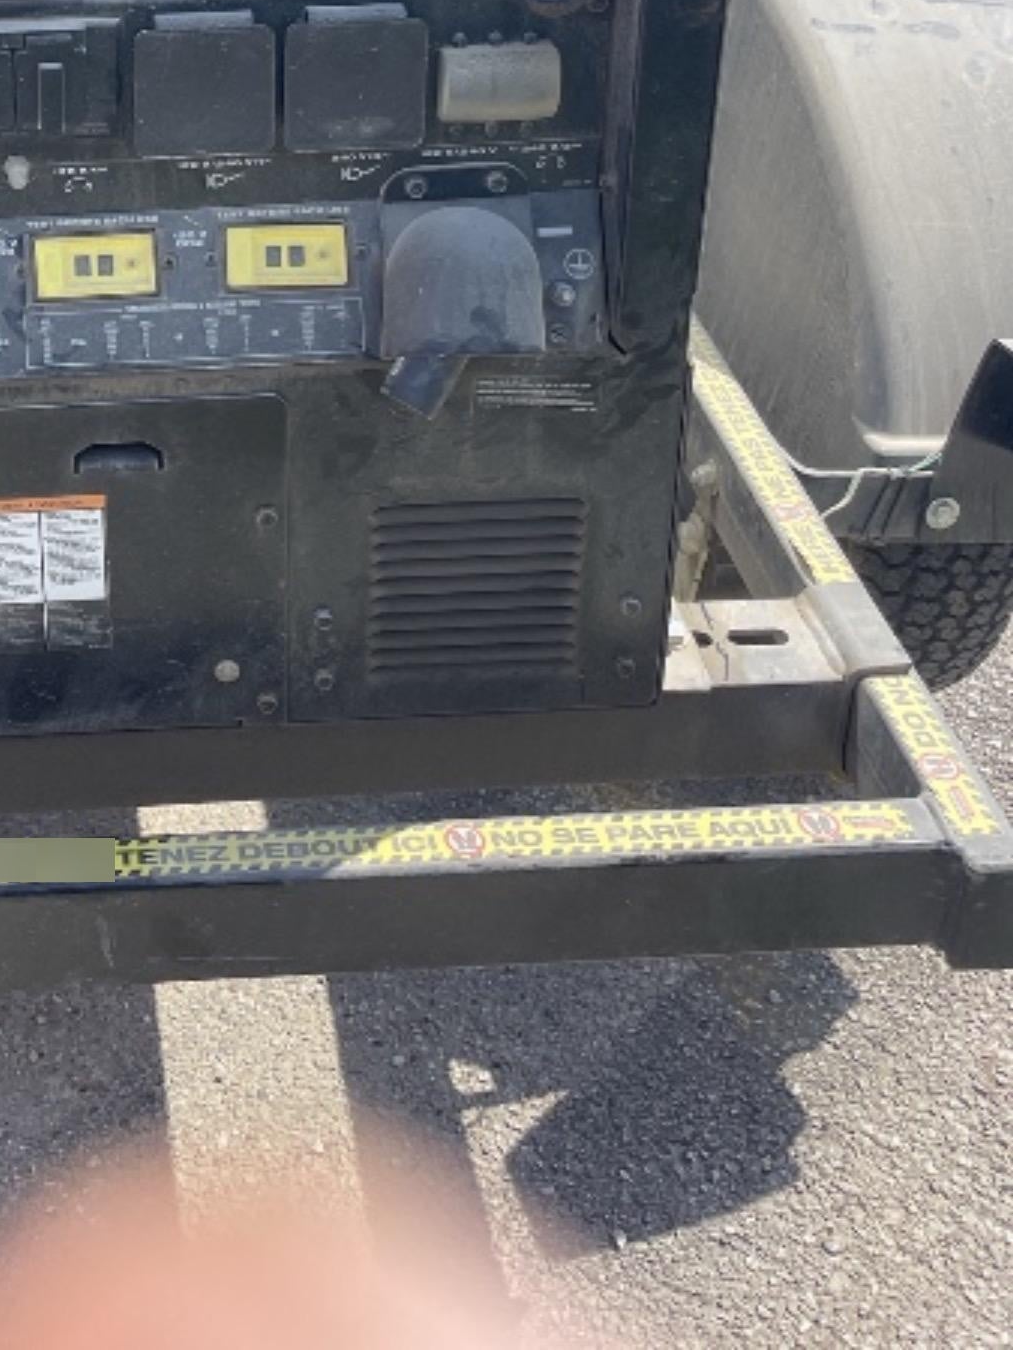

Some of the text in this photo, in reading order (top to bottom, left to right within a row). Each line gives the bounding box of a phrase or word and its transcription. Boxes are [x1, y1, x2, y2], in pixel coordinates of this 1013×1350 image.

[490, 816, 791, 848] NO SE PARE AQUI
[116, 835, 438, 865] TENEZ DEBOUT ICI
